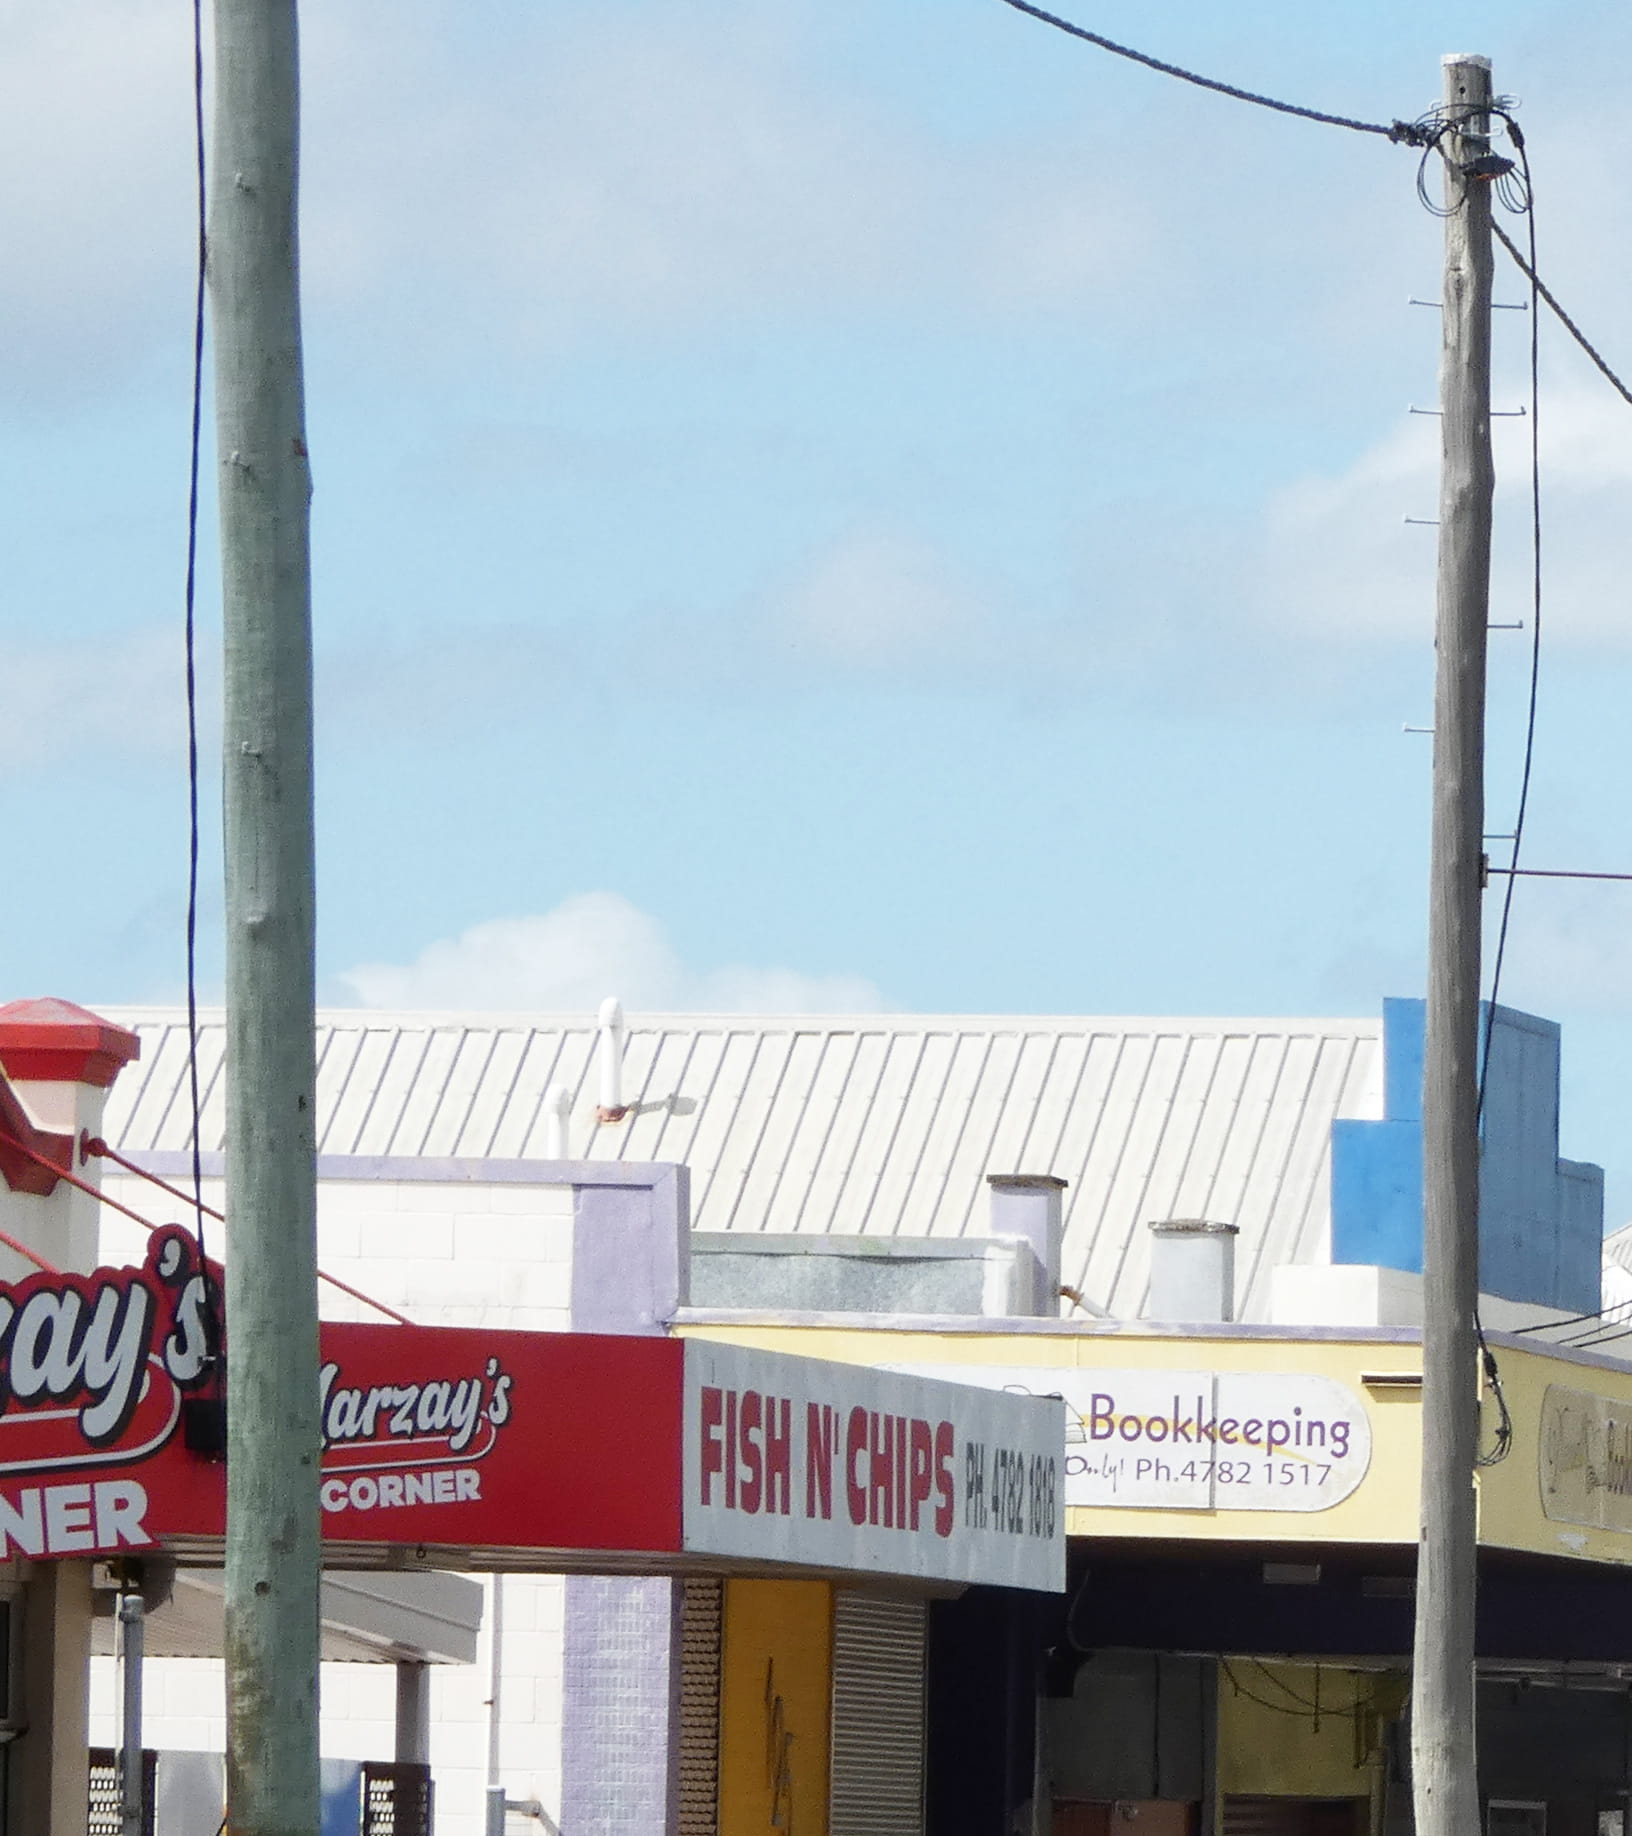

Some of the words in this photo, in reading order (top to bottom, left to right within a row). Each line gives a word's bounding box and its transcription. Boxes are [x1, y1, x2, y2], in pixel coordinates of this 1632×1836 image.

[0, 1238, 206, 1437] ay's
[1090, 1393, 1351, 1459] Bookkeeping
[320, 1469, 482, 1512] CORNER
[701, 1386, 791, 1515] FISH
[806, 1402, 839, 1520] N'
[846, 1406, 955, 1538] CHIPS
[965, 1442, 988, 1529] PH.
[991, 1447, 1024, 1535] 4782
[1136, 1458, 1251, 1484] Ph.4782
[1264, 1463, 1332, 1486] 1517
